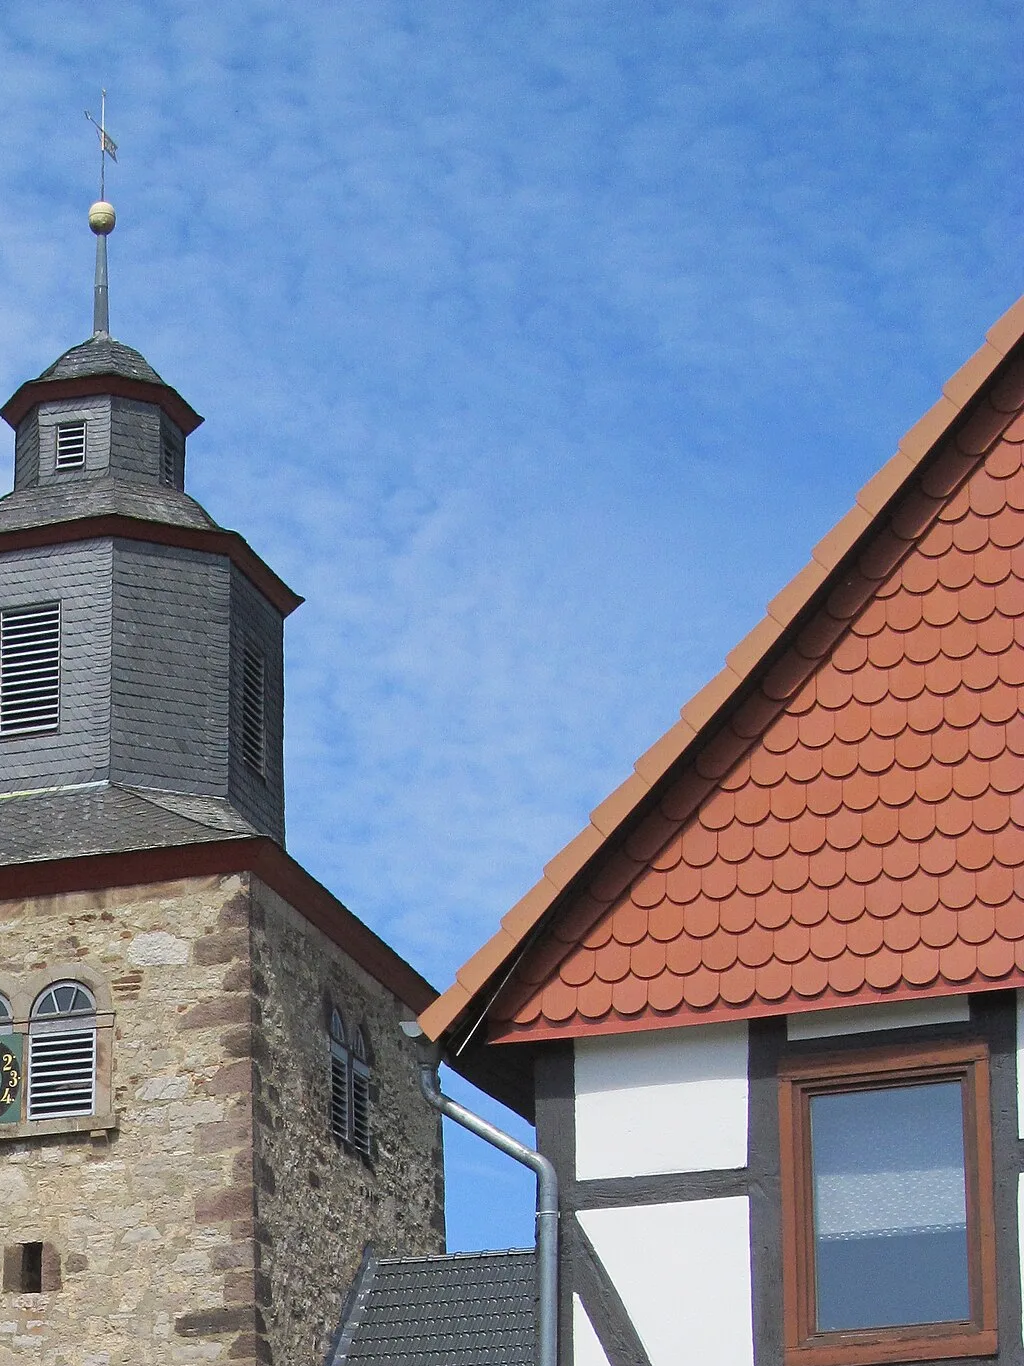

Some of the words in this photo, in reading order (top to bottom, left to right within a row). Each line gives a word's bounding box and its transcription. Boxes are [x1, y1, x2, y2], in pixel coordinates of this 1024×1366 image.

[2, 1054, 13, 1071] 2
[8, 1070, 18, 1087] 3
[0, 1088, 12, 1104] 4
